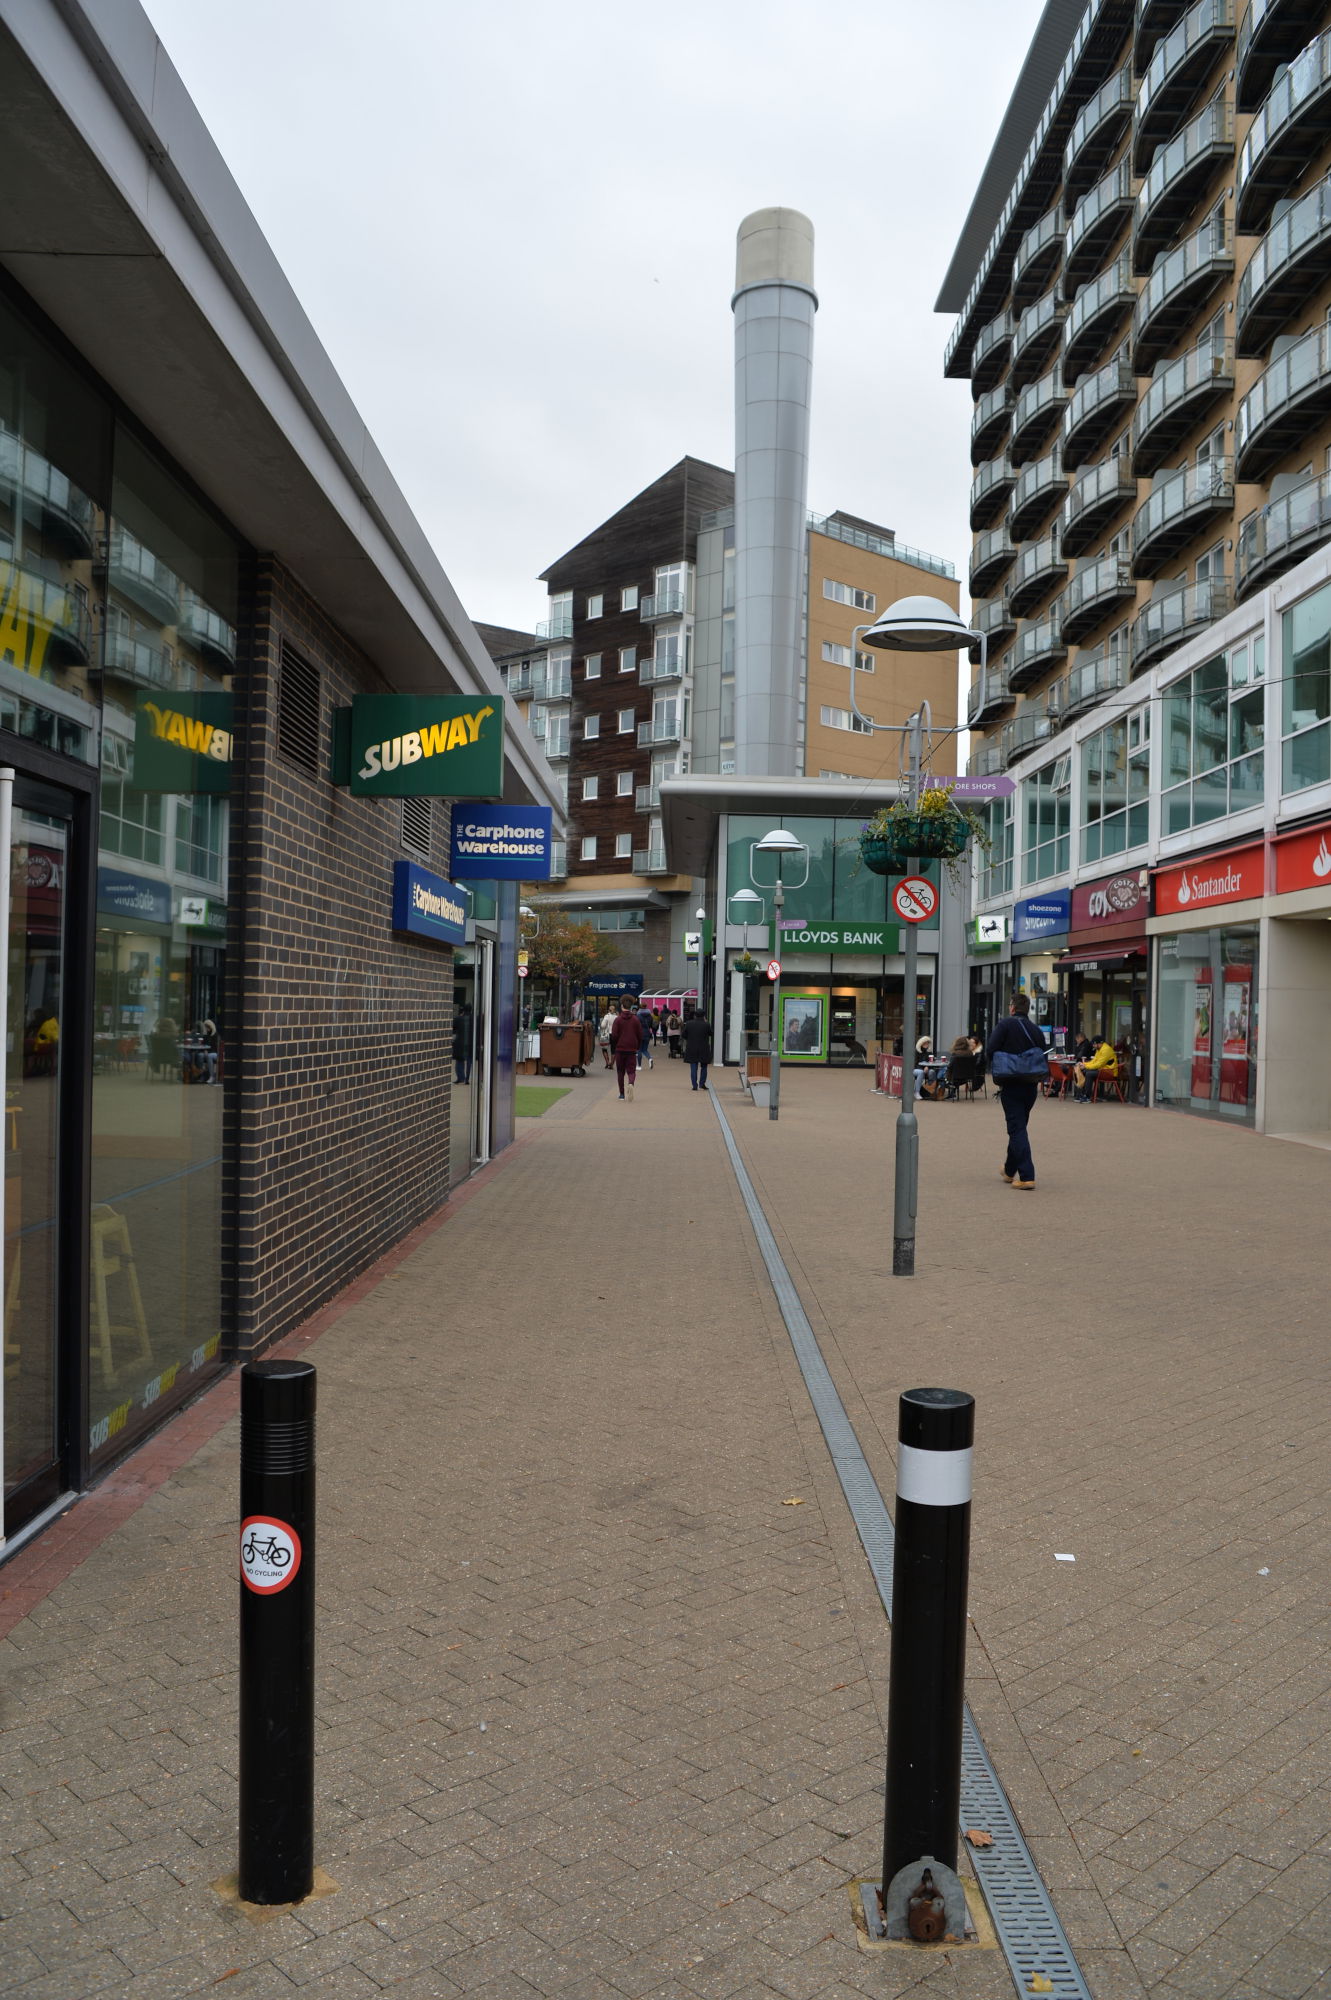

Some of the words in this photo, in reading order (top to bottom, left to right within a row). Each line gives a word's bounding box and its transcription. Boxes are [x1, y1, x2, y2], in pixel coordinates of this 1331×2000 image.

[358, 705, 495, 780] SUBWAY
[949, 783, 970, 791] ORE
[465, 824, 545, 840] Carphone
[457, 841, 545, 855] Warehouse
[1114, 880, 1135, 889] COSTA
[1192, 864, 1242, 900] Santander
[416, 884, 440, 916] Carphone
[440, 896, 465, 926] Warehouse
[1028, 904, 1062, 913] shoezone
[1112, 896, 1137, 908] COFFEE
[784, 931, 839, 944] LLOYDS
[843, 932, 884, 945] BANK
[588, 981, 618, 989] Fragrance
[142, 1361, 180, 1410] SUBWAY
[89, 1397, 133, 1455] SUBWAY
[246, 1567, 254, 1575] NO
